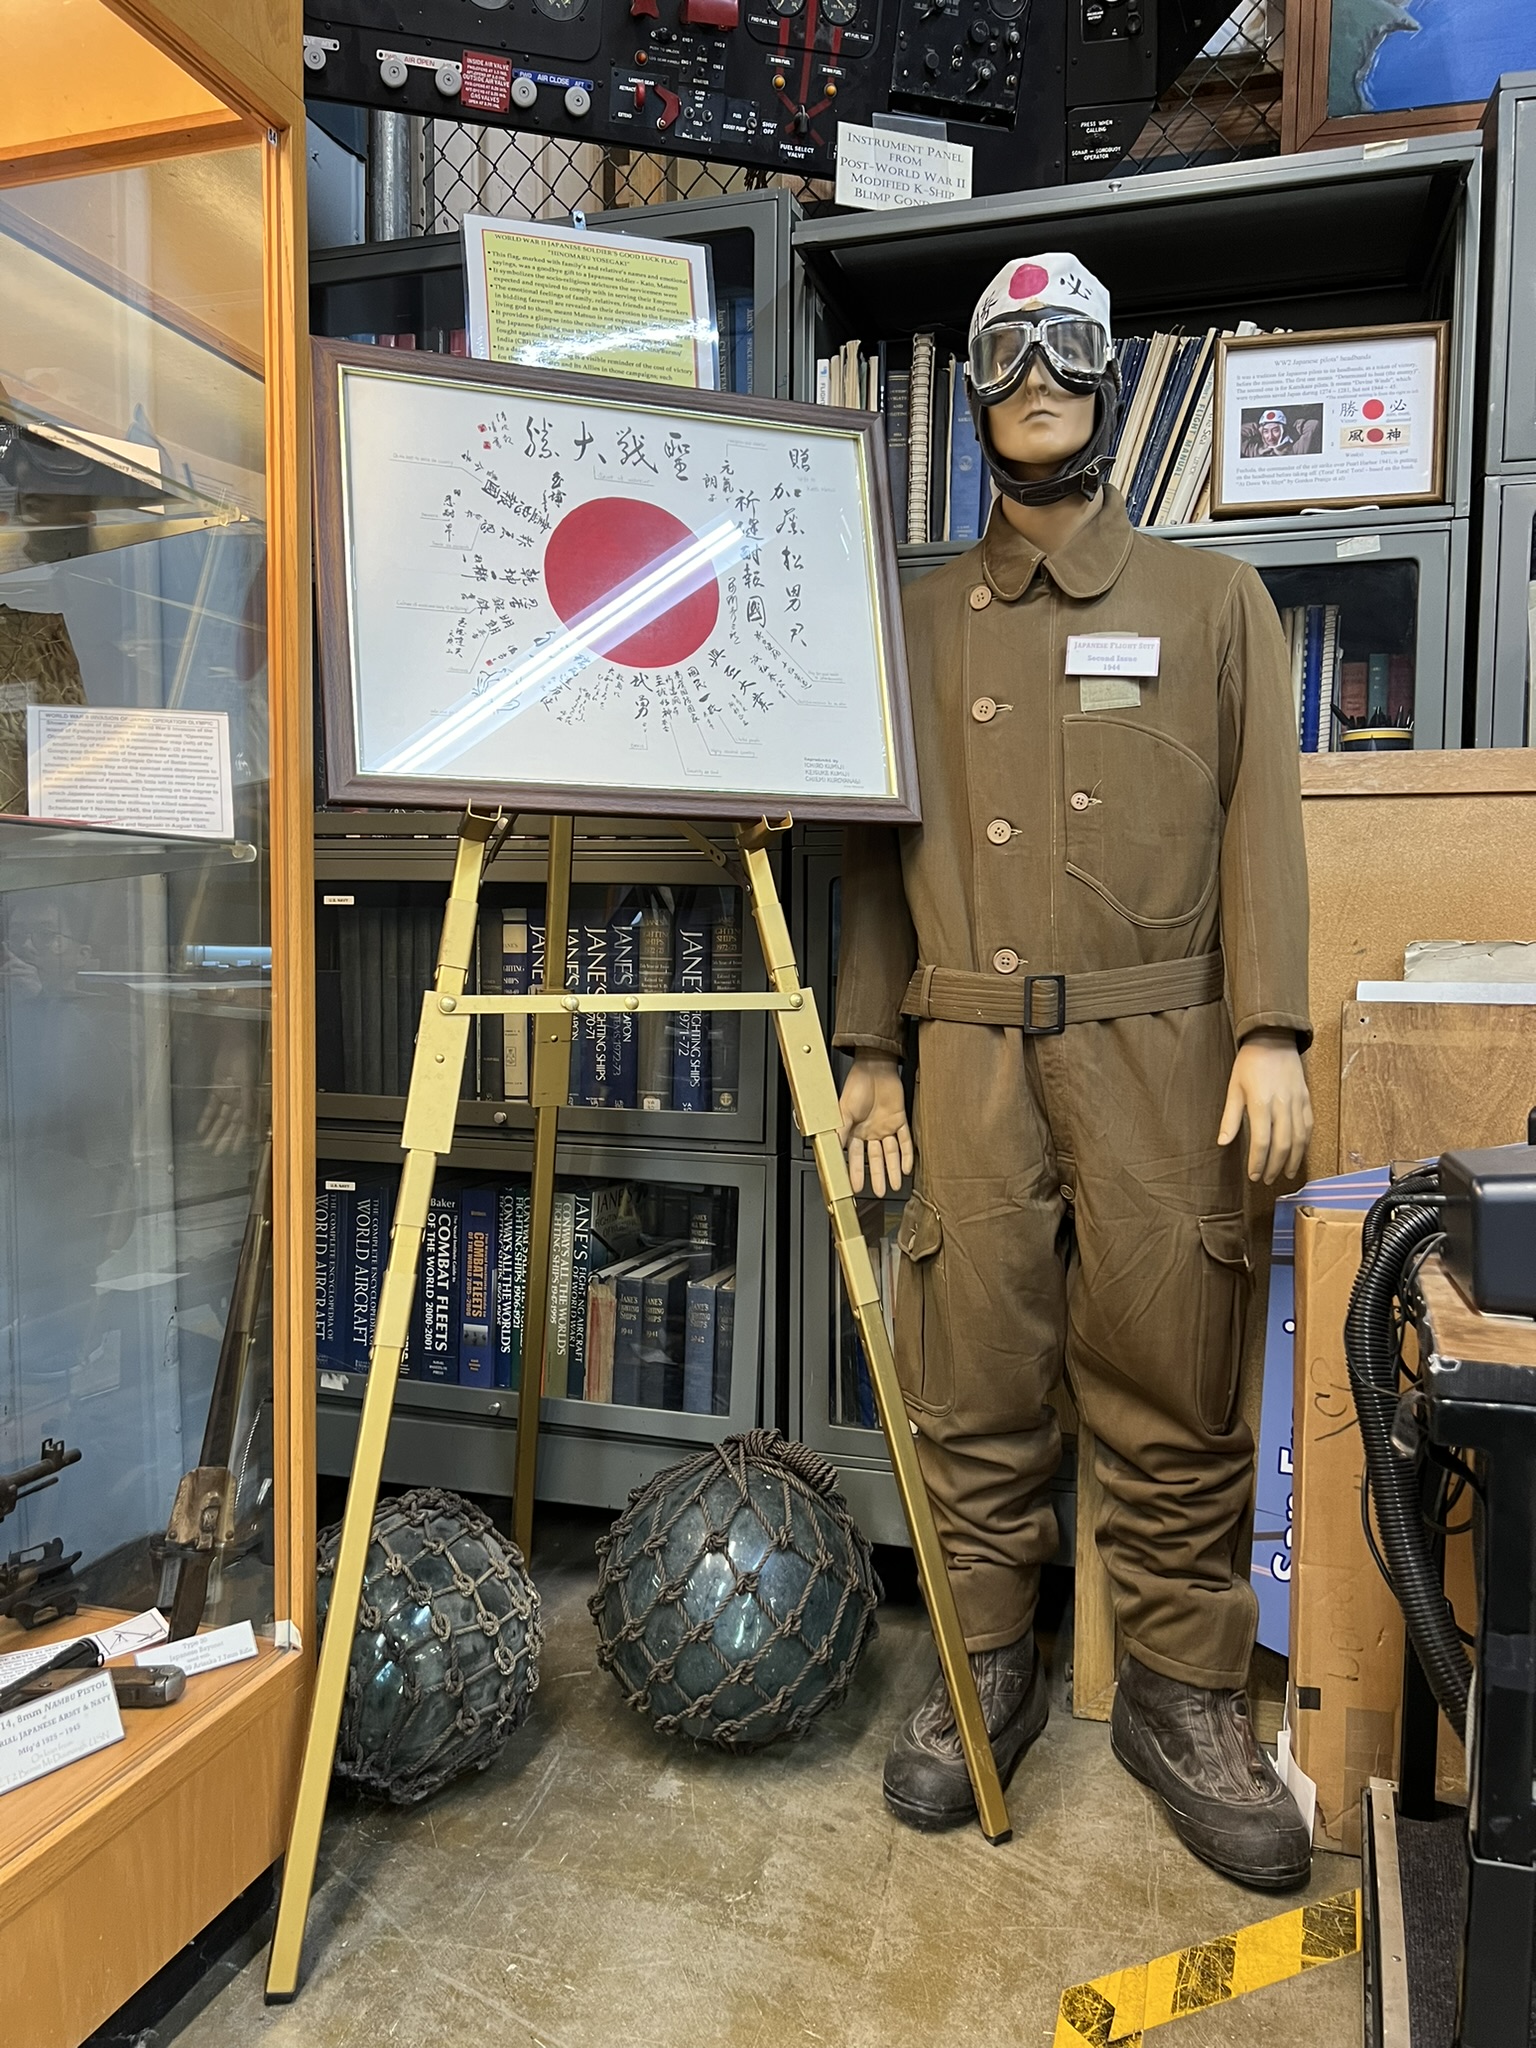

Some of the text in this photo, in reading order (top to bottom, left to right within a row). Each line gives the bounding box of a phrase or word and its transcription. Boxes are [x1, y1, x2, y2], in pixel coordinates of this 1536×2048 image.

[404, 56, 436, 66] AIR OPEN
[493, 62, 510, 71] VALVE
[462, 74, 484, 83] OUTSIDE
[494, 79, 510, 88] VALVE
[537, 74, 549, 82] AIR
[549, 75, 570, 86] CLOSE
[762, 121, 778, 129] SHUT
[780, 143, 815, 154] FUEL SELECT
[787, 151, 805, 160] VALVE
[847, 132, 964, 163] INSTRUMENT PANEL
[889, 152, 922, 166] FROM
[1083, 153, 1110, 161] OPERATOR
[840, 156, 966, 189] POST-WORLD WAR II
[851, 172, 955, 200] MODIFIED K-SHIP
[855, 187, 935, 206] BLIMP GOND
[494, 233, 522, 242] WORLD
[523, 237, 540, 245] WAR
[547, 241, 581, 251] JAPANESE
[582, 246, 618, 257] SOLDIER'S
[619, 251, 641, 260] GOOD
[641, 255, 660, 263] LUCK
[660, 258, 679, 266] FLAG
[522, 255, 546, 263] marked
[562, 260, 586, 270] family's
[536, 265, 562, 274] goodbye
[588, 272, 614, 282] Japanese
[1339, 398, 1407, 418] 勝 必
[1173, 403, 1206, 476] FLIGHT MANUAL
[1347, 427, 1402, 442] 風 神
[1073, 641, 1109, 650] JAPANESE
[1109, 642, 1137, 650] FLIGHT
[1087, 654, 1138, 663] Second Issue
[583, 925, 608, 995] JANE'S
[611, 923, 636, 988] JANE'S
[679, 928, 704, 993] JANE'
[595, 1012, 607, 1082] GHTING SHIPS
[689, 1059, 701, 1088] SHIPS
[430, 1198, 457, 1209] Baker
[371, 1217, 380, 1265] COMPLETE
[573, 1195, 591, 1260] JANE'S
[551, 1202, 563, 1284] FIGHTING SHIPS
[316, 1193, 329, 1340] WORLD AIRCRAFT
[327, 1212, 337, 1327] COMPLETE ENCYCLOPEDIA
[352, 1198, 371, 1347] WORLD AIRCRAFT
[471, 1231, 485, 1318] COMBAT FLEETS
[502, 1252, 513, 1275] ALL
[513, 1196, 524, 1329] FIGHTING SHIPS 1906-1921
[559, 1259, 570, 1280] ALL
[424, 1212, 437, 1351] OF THE WORLD 2000-2001
[434, 1213, 452, 1352] COMBAT FLEETS
[502, 1275, 512, 1300] THE
[558, 1282, 569, 1305] THE
[569, 1320, 577, 1343] WAR
[574, 1316, 585, 1363] AIRCRAFT
[620, 1327, 633, 1335] 1941
[0, 1680, 109, 1731] 14, 8mm NAMBU PISTOL
[0, 1734, 18, 1748] RIAL
[19, 1717, 58, 1740] JAPANESE
[58, 1708, 81, 1721] ARMY
[91, 1694, 112, 1707] NAVY
[18, 1723, 81, 1756] Mfg'd 1925 1945
